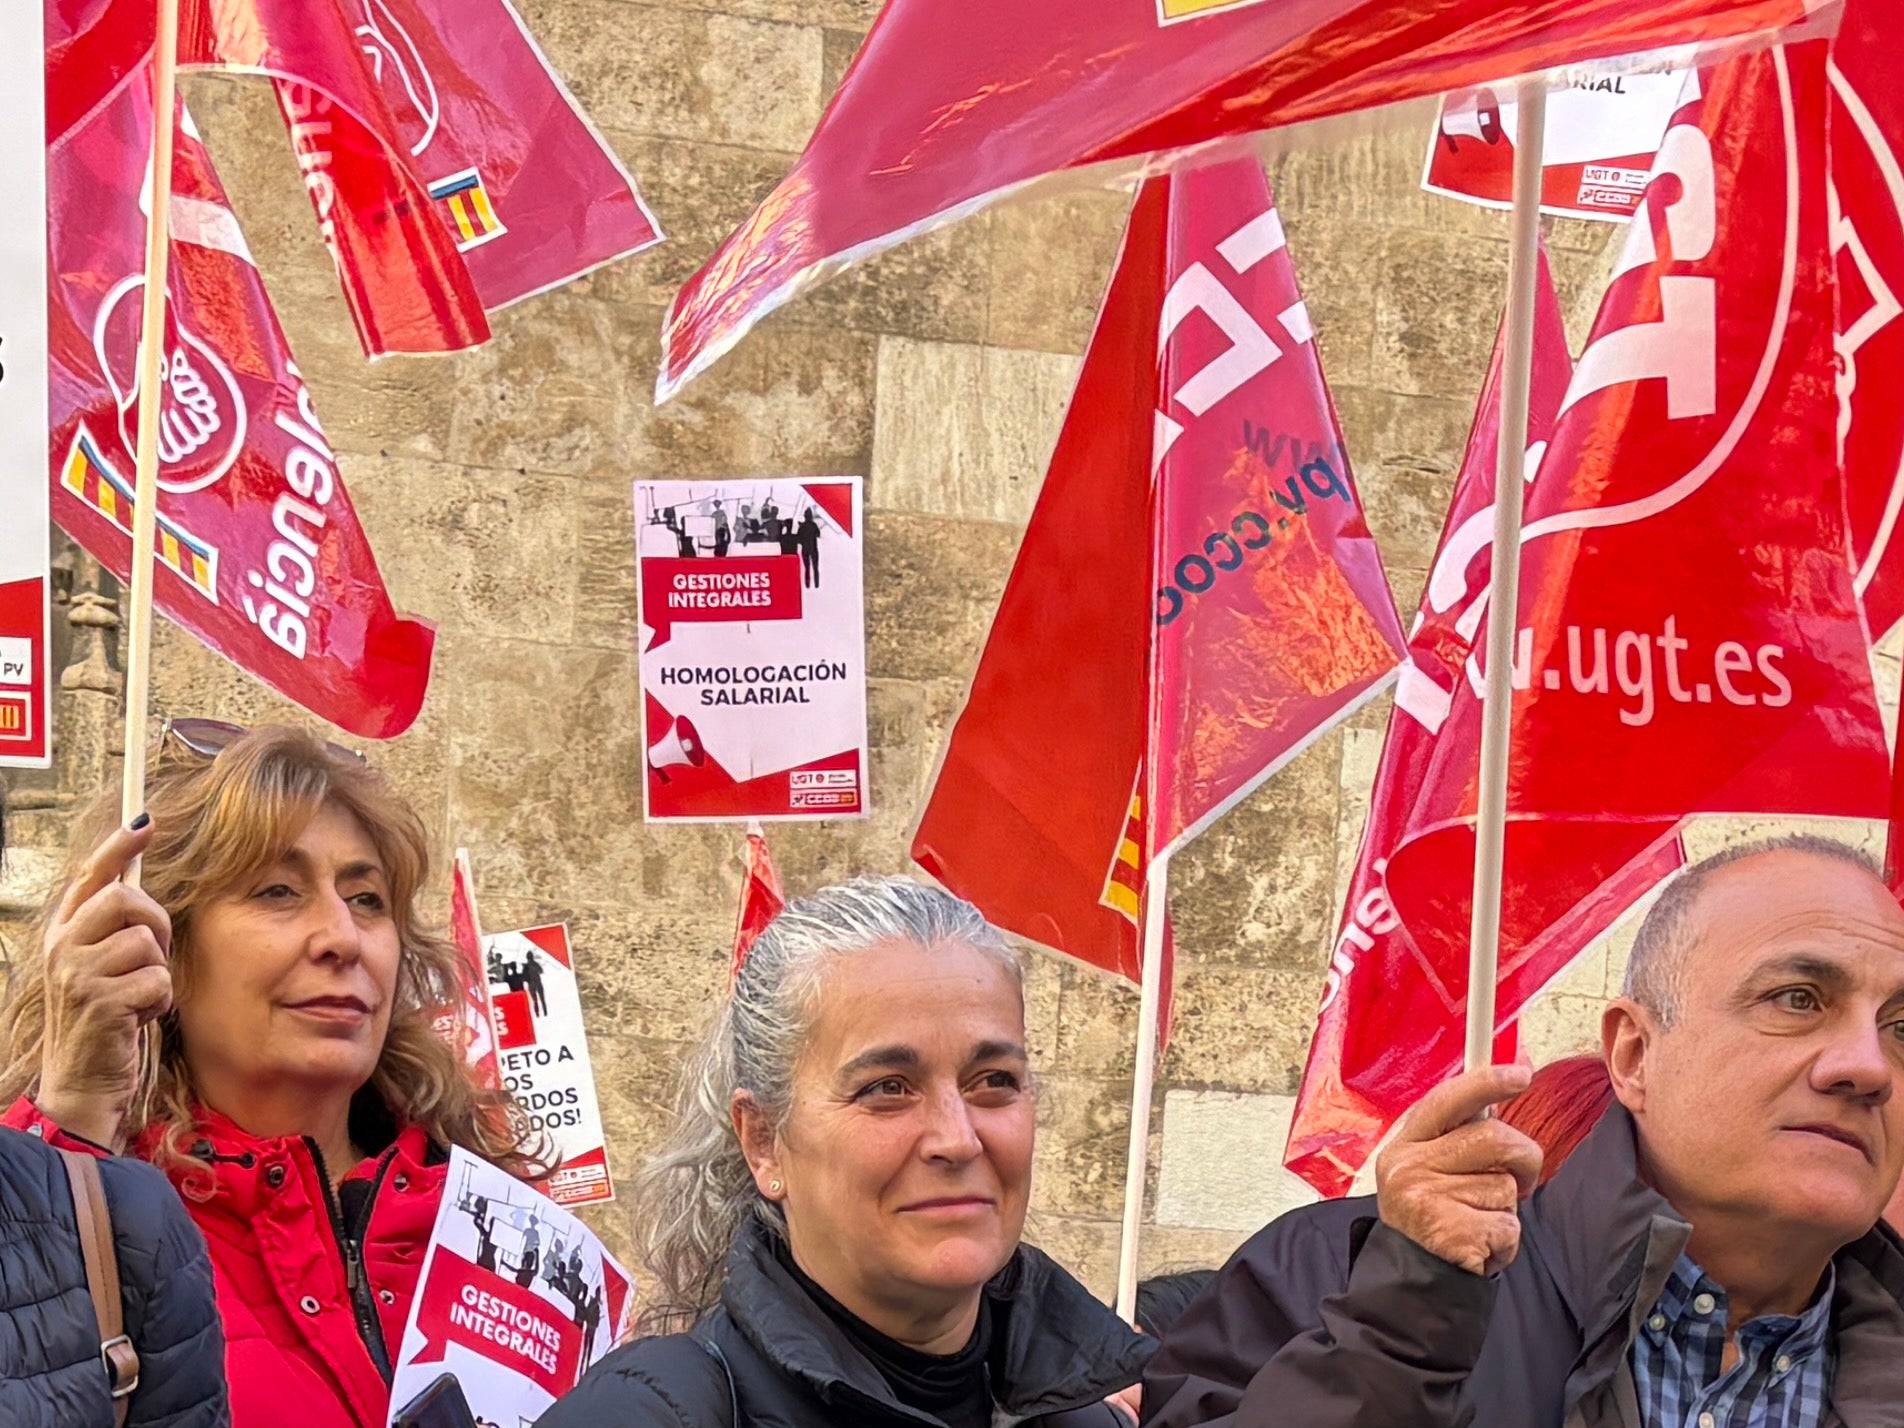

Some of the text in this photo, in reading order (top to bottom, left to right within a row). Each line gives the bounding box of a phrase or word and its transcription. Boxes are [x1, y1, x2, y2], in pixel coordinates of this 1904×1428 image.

[673, 572, 771, 591] GESTIONES
[668, 590, 771, 609] INTEGRALES
[660, 660, 848, 686] HOMOLOGACIÓN
[700, 686, 812, 706] SALARIAL
[557, 1045, 575, 1063] A
[461, 1283, 562, 1351] GESTIONES
[449, 1302, 558, 1376] INTEGRALES
